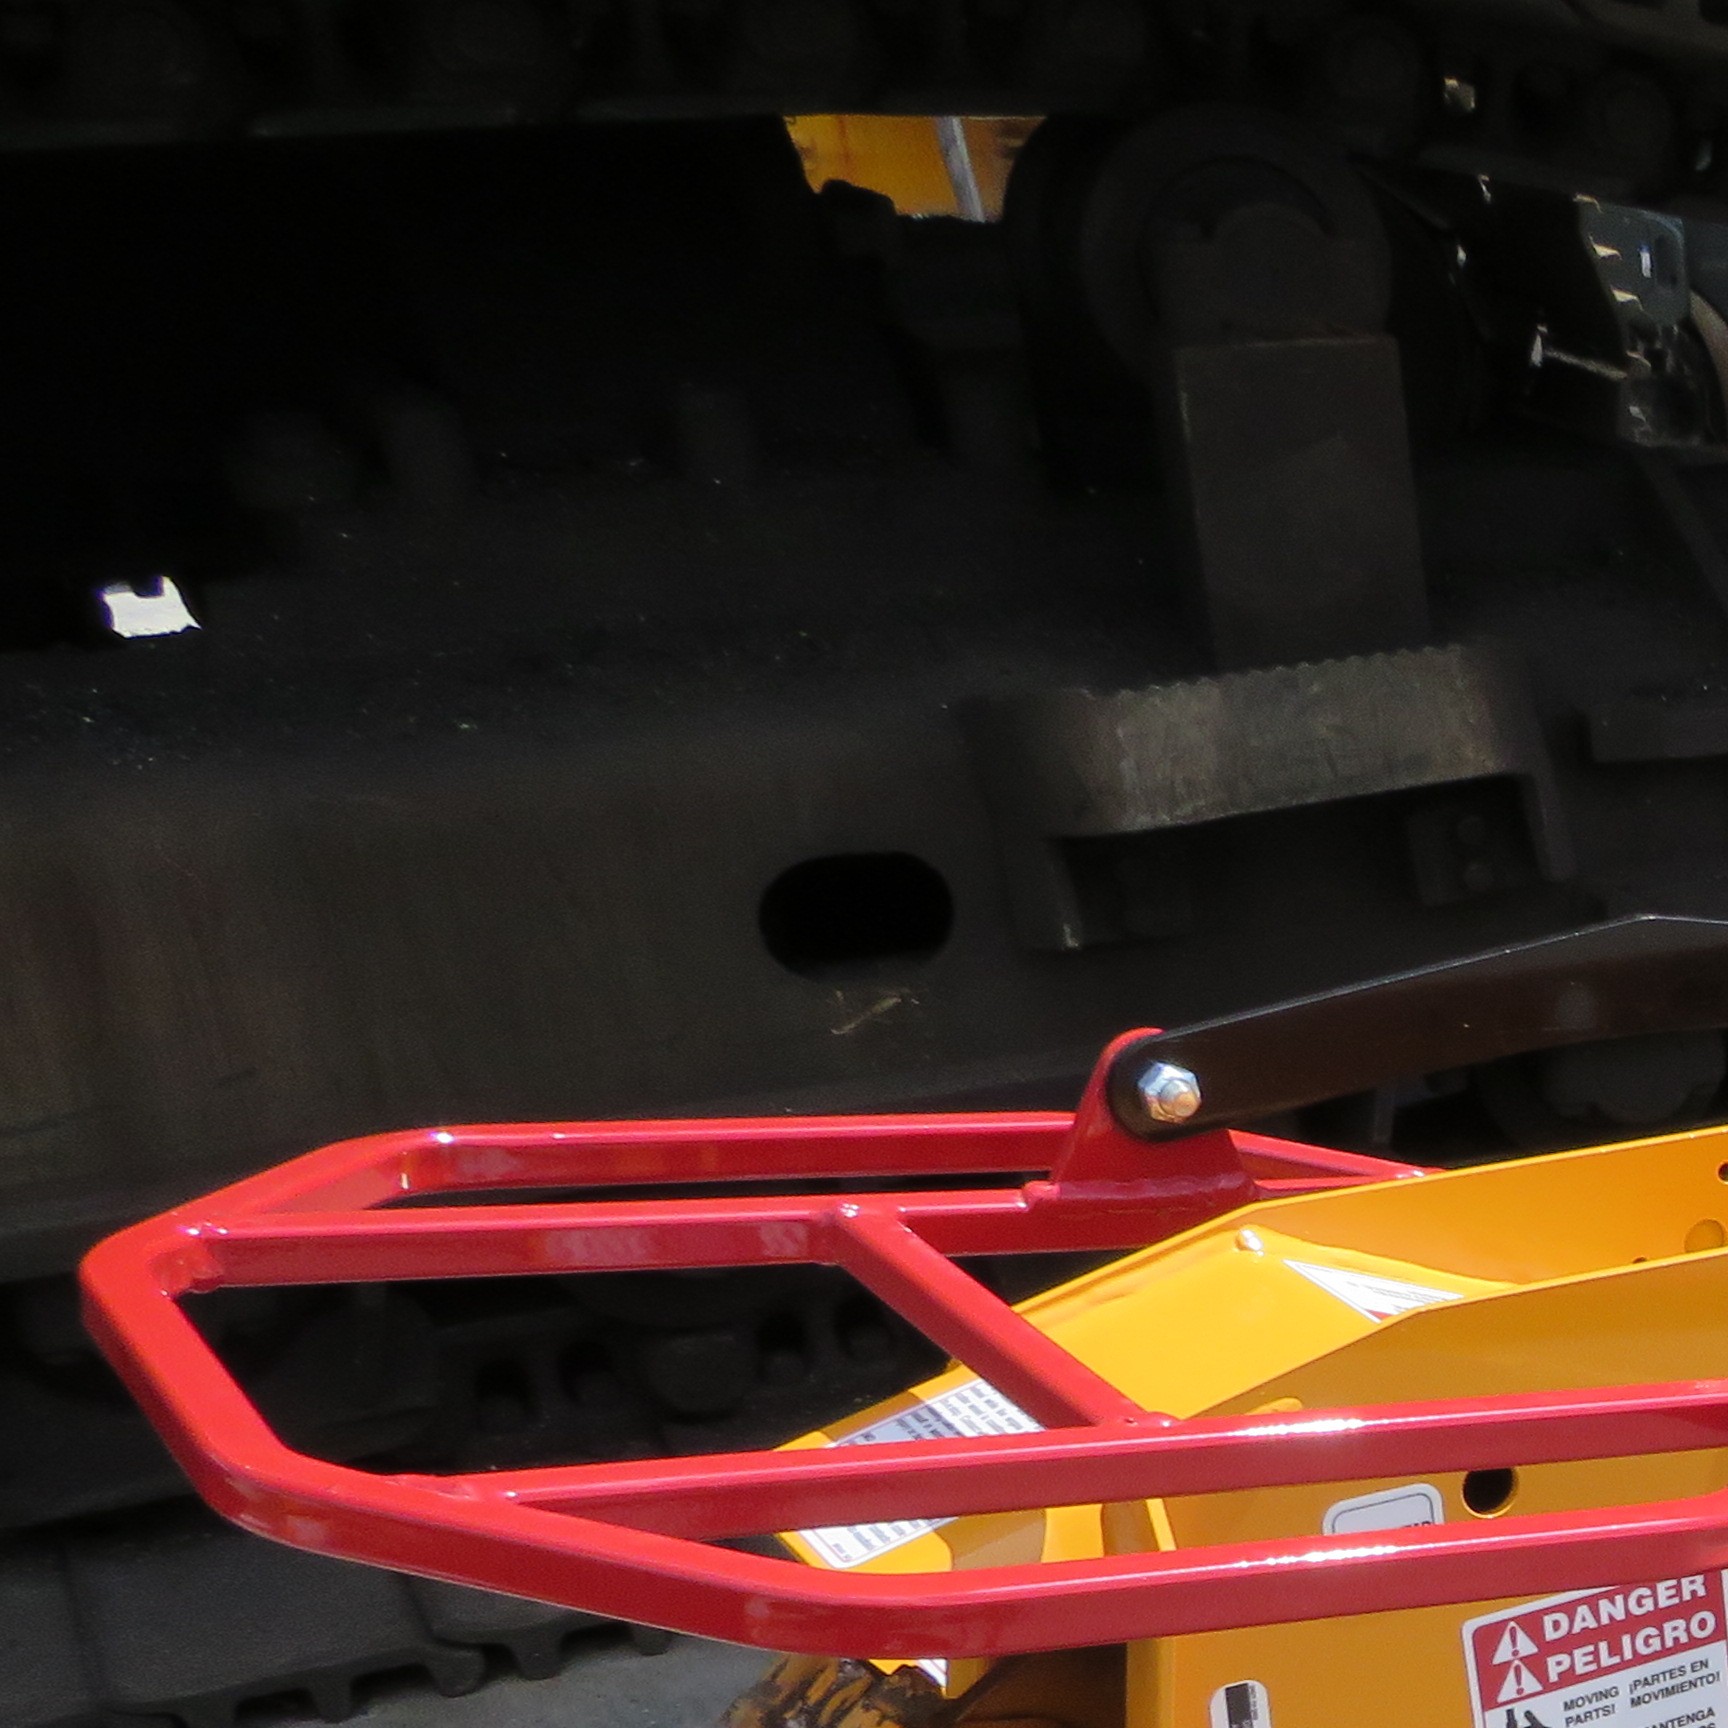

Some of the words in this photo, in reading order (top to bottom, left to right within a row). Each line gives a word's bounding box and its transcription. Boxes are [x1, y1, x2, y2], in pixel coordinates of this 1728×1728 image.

[1542, 1574, 1707, 1642] DANGER
[1546, 1610, 1717, 1683] PELIGRO
[1629, 1665, 1686, 1696] ¡PARTES
[1690, 1658, 1710, 1675] EN
[1630, 1671, 1721, 1708] MOVIMIENTO!
[1563, 1685, 1620, 1712] MOVING
[1564, 1704, 1616, 1728] PARTS!
